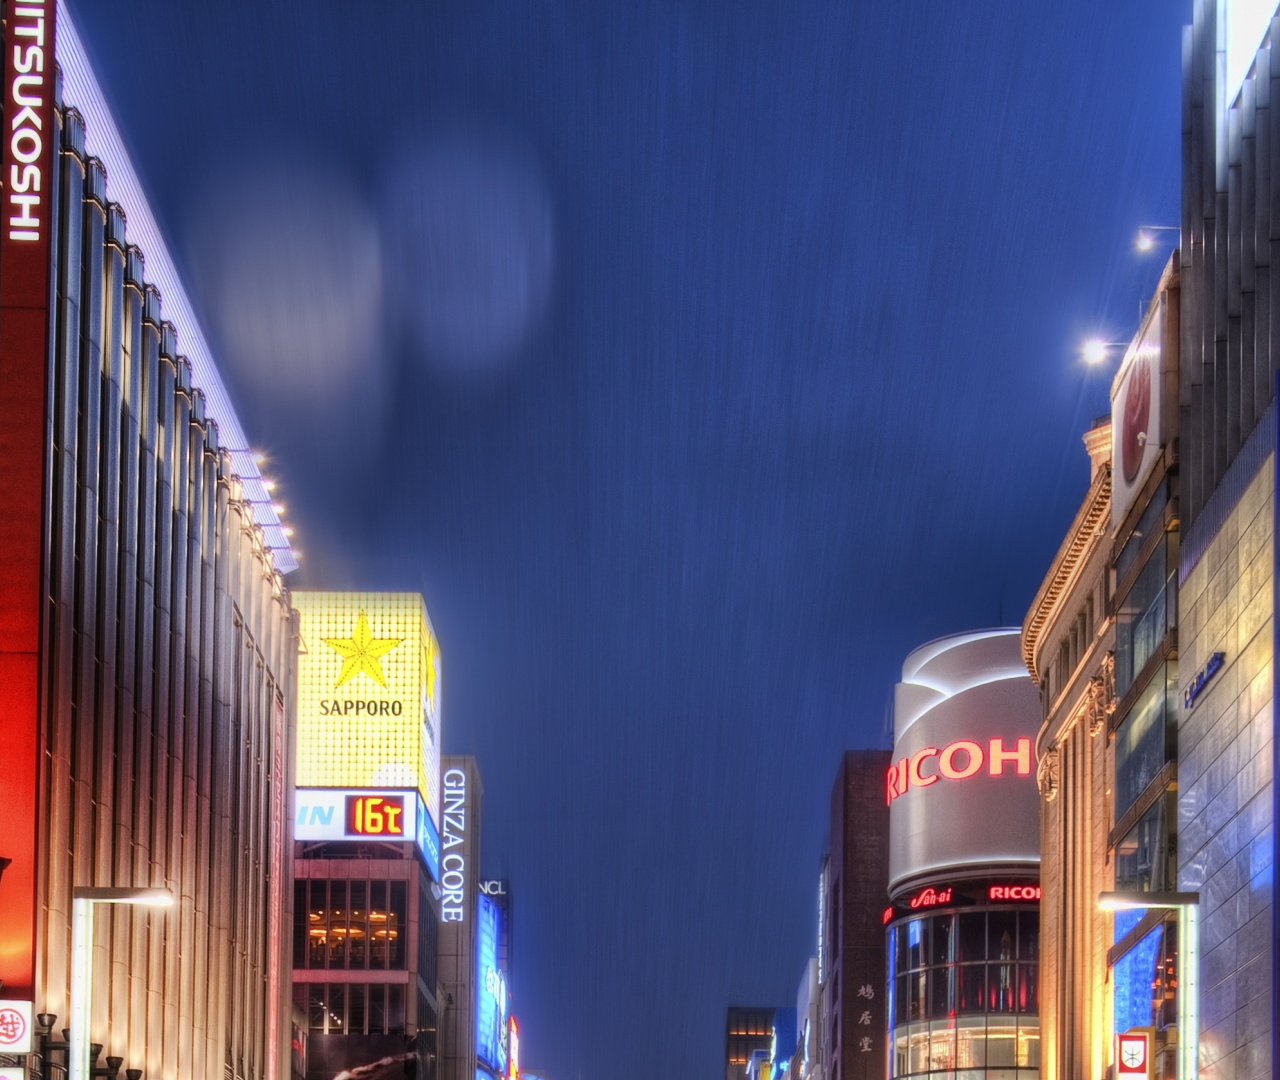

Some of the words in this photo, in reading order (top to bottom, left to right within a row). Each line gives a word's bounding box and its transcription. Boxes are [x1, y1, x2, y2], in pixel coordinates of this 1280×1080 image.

[9, 0, 45, 241] ITSUKOSHI
[320, 699, 403, 717] SAPPORO
[886, 737, 1031, 806] RICOH
[442, 768, 466, 849] GINZA
[441, 854, 465, 922] CORE
[857, 984, 875, 1052] 鳩居堂
